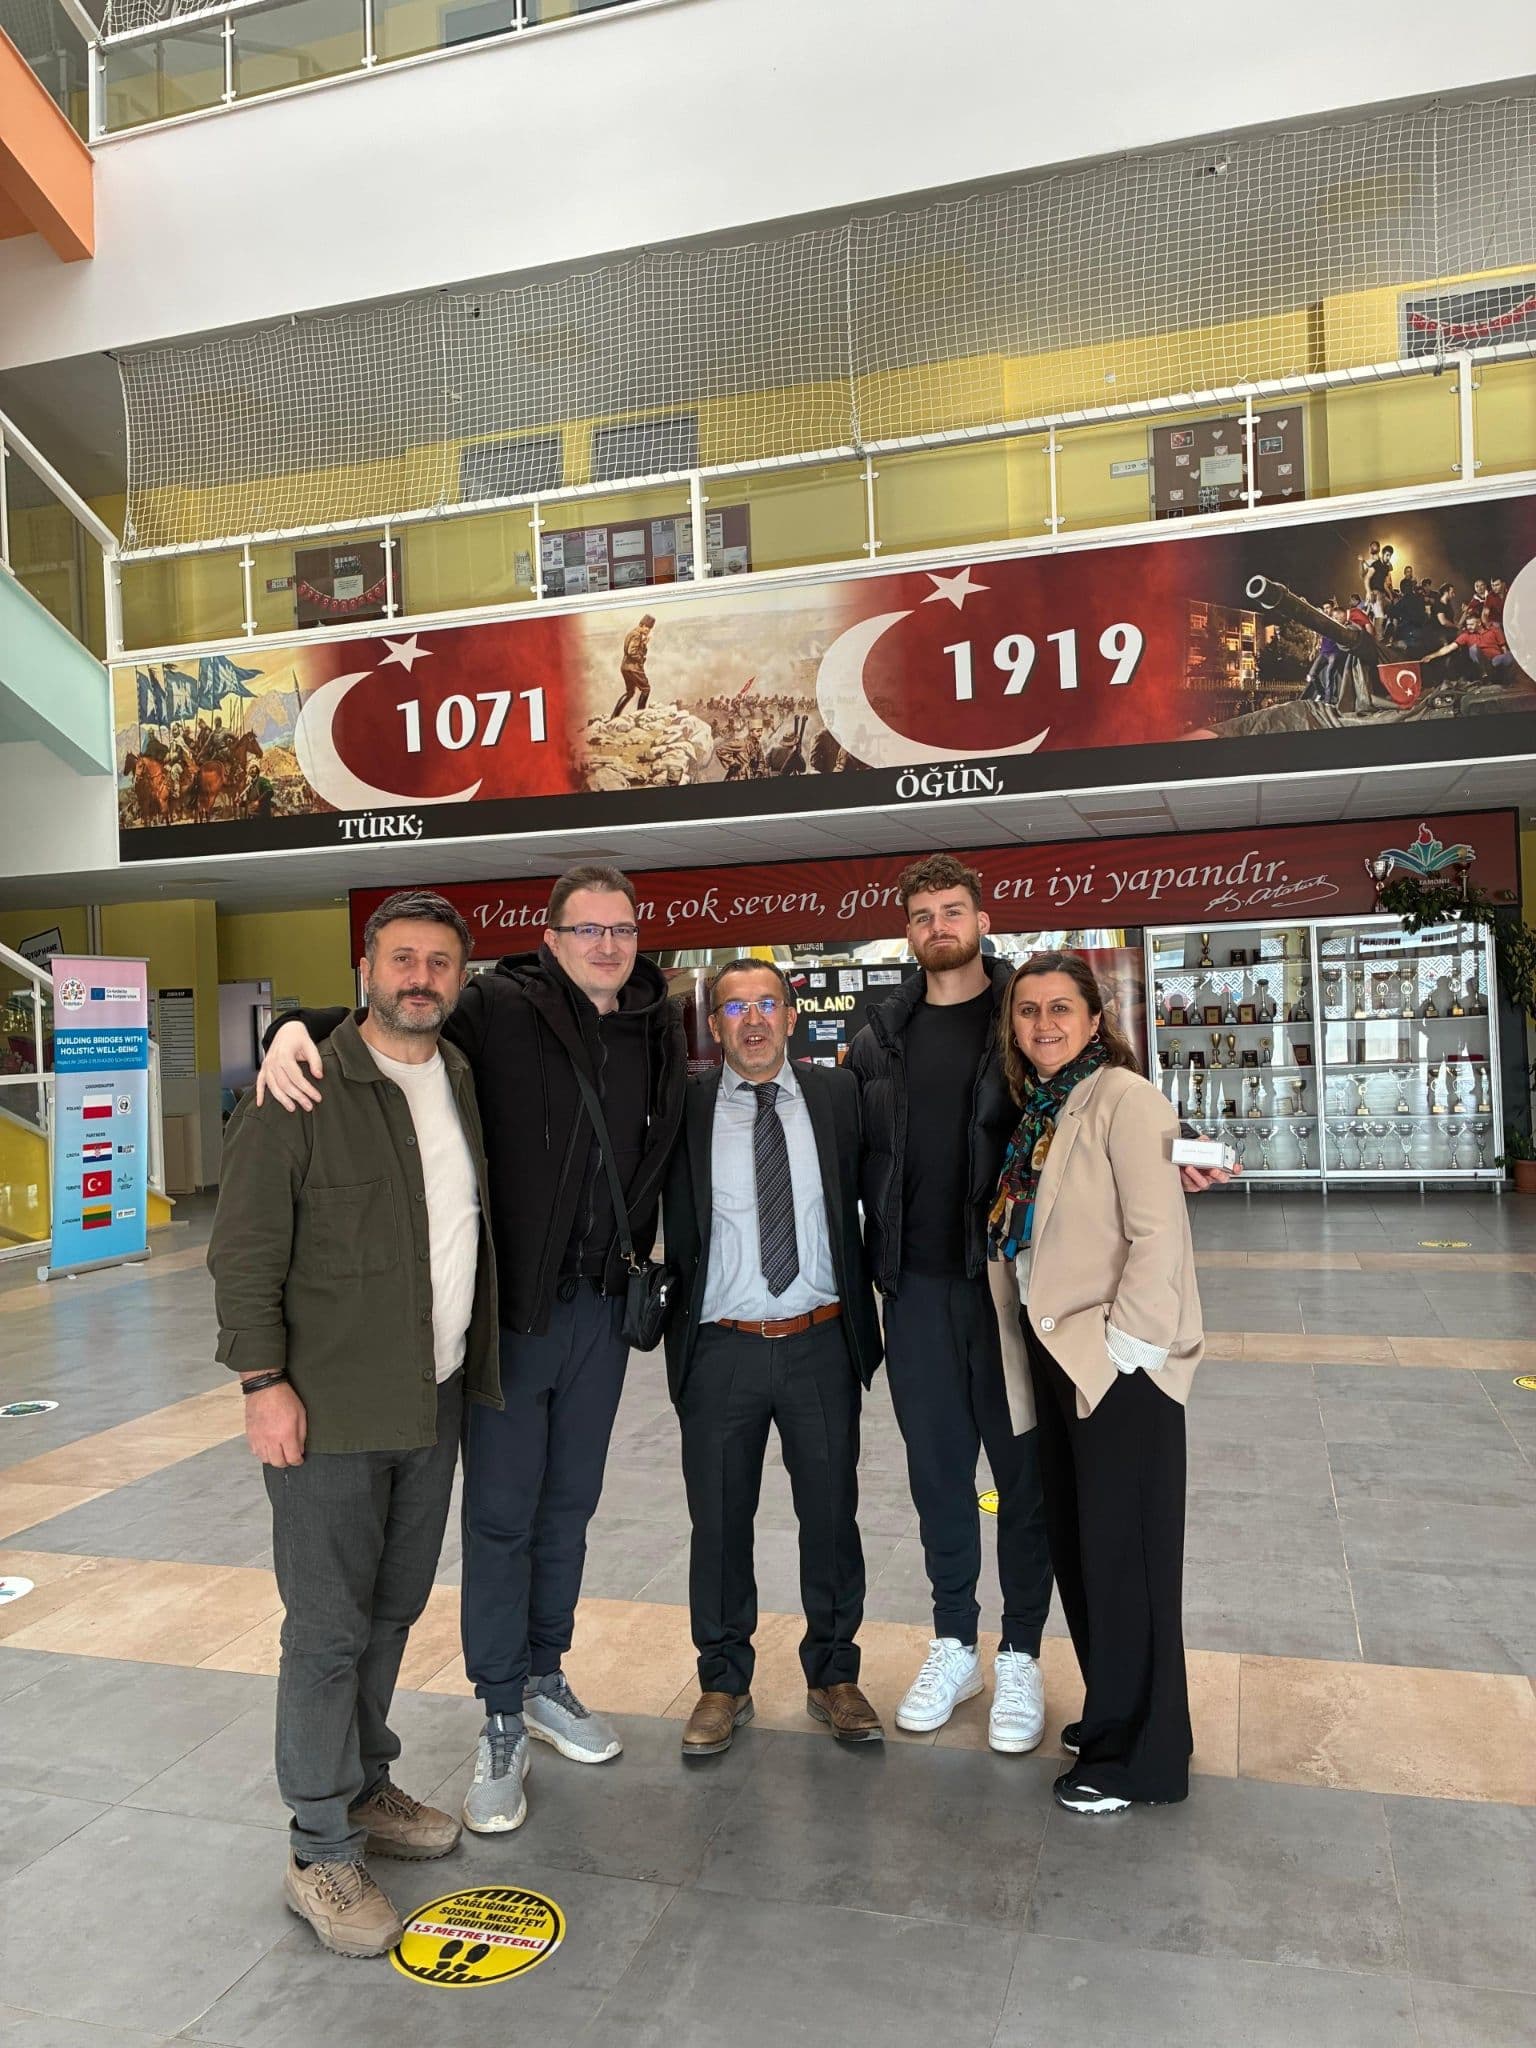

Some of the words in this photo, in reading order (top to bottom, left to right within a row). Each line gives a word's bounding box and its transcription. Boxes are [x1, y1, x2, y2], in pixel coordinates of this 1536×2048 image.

[943, 623, 1143, 700] 1919
[397, 687, 546, 753] 1071
[896, 765, 1004, 799] ÖĞÜN,
[339, 815, 423, 840] TÜRK;
[473, 900, 548, 928] Vata
[666, 887, 728, 927] çok
[729, 888, 825, 917] seven,
[993, 876, 1035, 900] en
[1049, 864, 1095, 906] iyi
[1104, 851, 1288, 905] yapandır.
[796, 994, 856, 1014] POLAND
[56, 1037, 91, 1045] BUILDING
[93, 1036, 123, 1044] BRIDGES
[124, 1035, 143, 1043] WITH
[60, 1047, 95, 1055] HOLISTIC
[96, 1045, 138, 1054] WELL-BEING
[439, 1907, 483, 1919] SOSYAL
[485, 1912, 548, 1928] MESAFEYİ
[453, 1897, 518, 1914] SAĞLIĞINIZ
[521, 1905, 547, 1918] İÇİN
[413, 1923, 431, 1934] 1,5
[432, 1926, 482, 1941] METRE
[485, 1933, 546, 1950] YETERLİ
[445, 1917, 518, 1934] KORUYUNUZ
